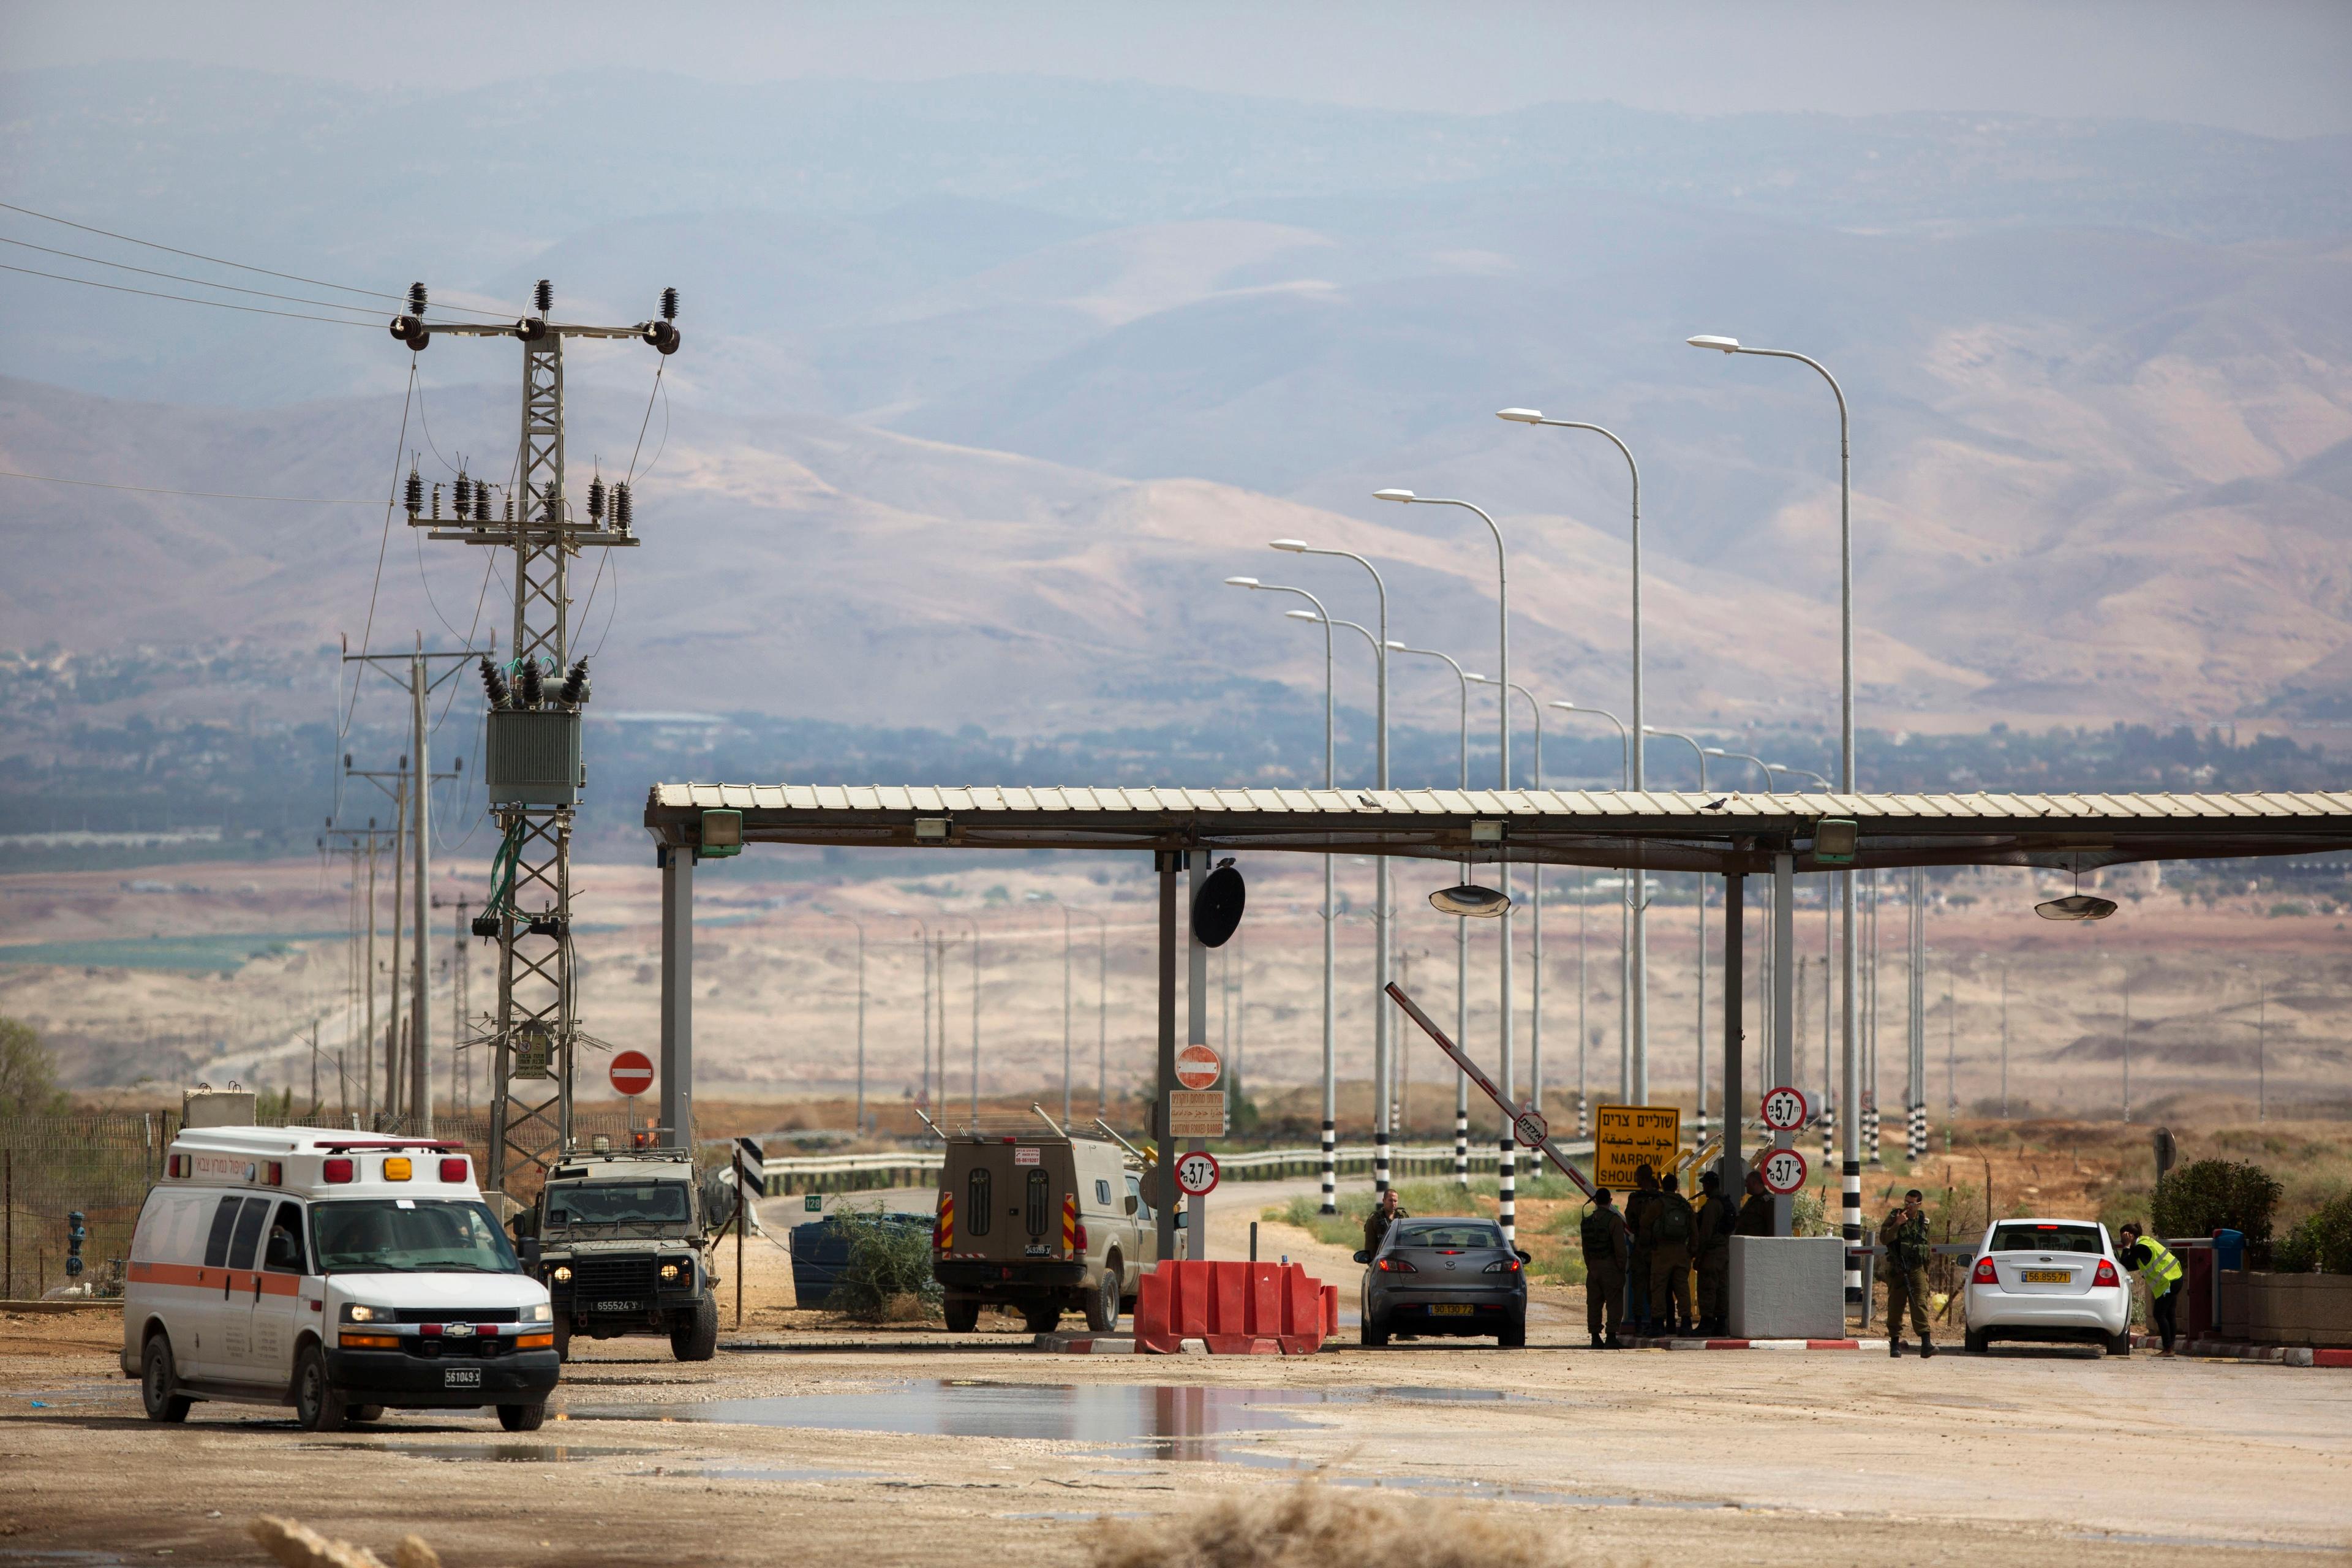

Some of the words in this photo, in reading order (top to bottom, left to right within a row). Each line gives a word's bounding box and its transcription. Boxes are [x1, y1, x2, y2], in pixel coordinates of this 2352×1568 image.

[1776, 1099, 1793, 1120] 5.7
[1603, 1114, 1629, 1127] צרים
[1637, 1114, 1673, 1128] שוליים
[1519, 1118, 1543, 1140] אילנית
[1602, 1133, 1633, 1148] ضيقة
[1637, 1136, 1672, 1151] جوانب
[195, 1157, 209, 1171] צבאי
[211, 1158, 227, 1176] נמרץ
[228, 1155, 246, 1175] טיפול
[1611, 1153, 1663, 1166] NARROW
[1189, 1163, 1204, 1184] 3.7
[1776, 1160, 1791, 1182] 3.7
[806, 1199, 820, 1208] 128
